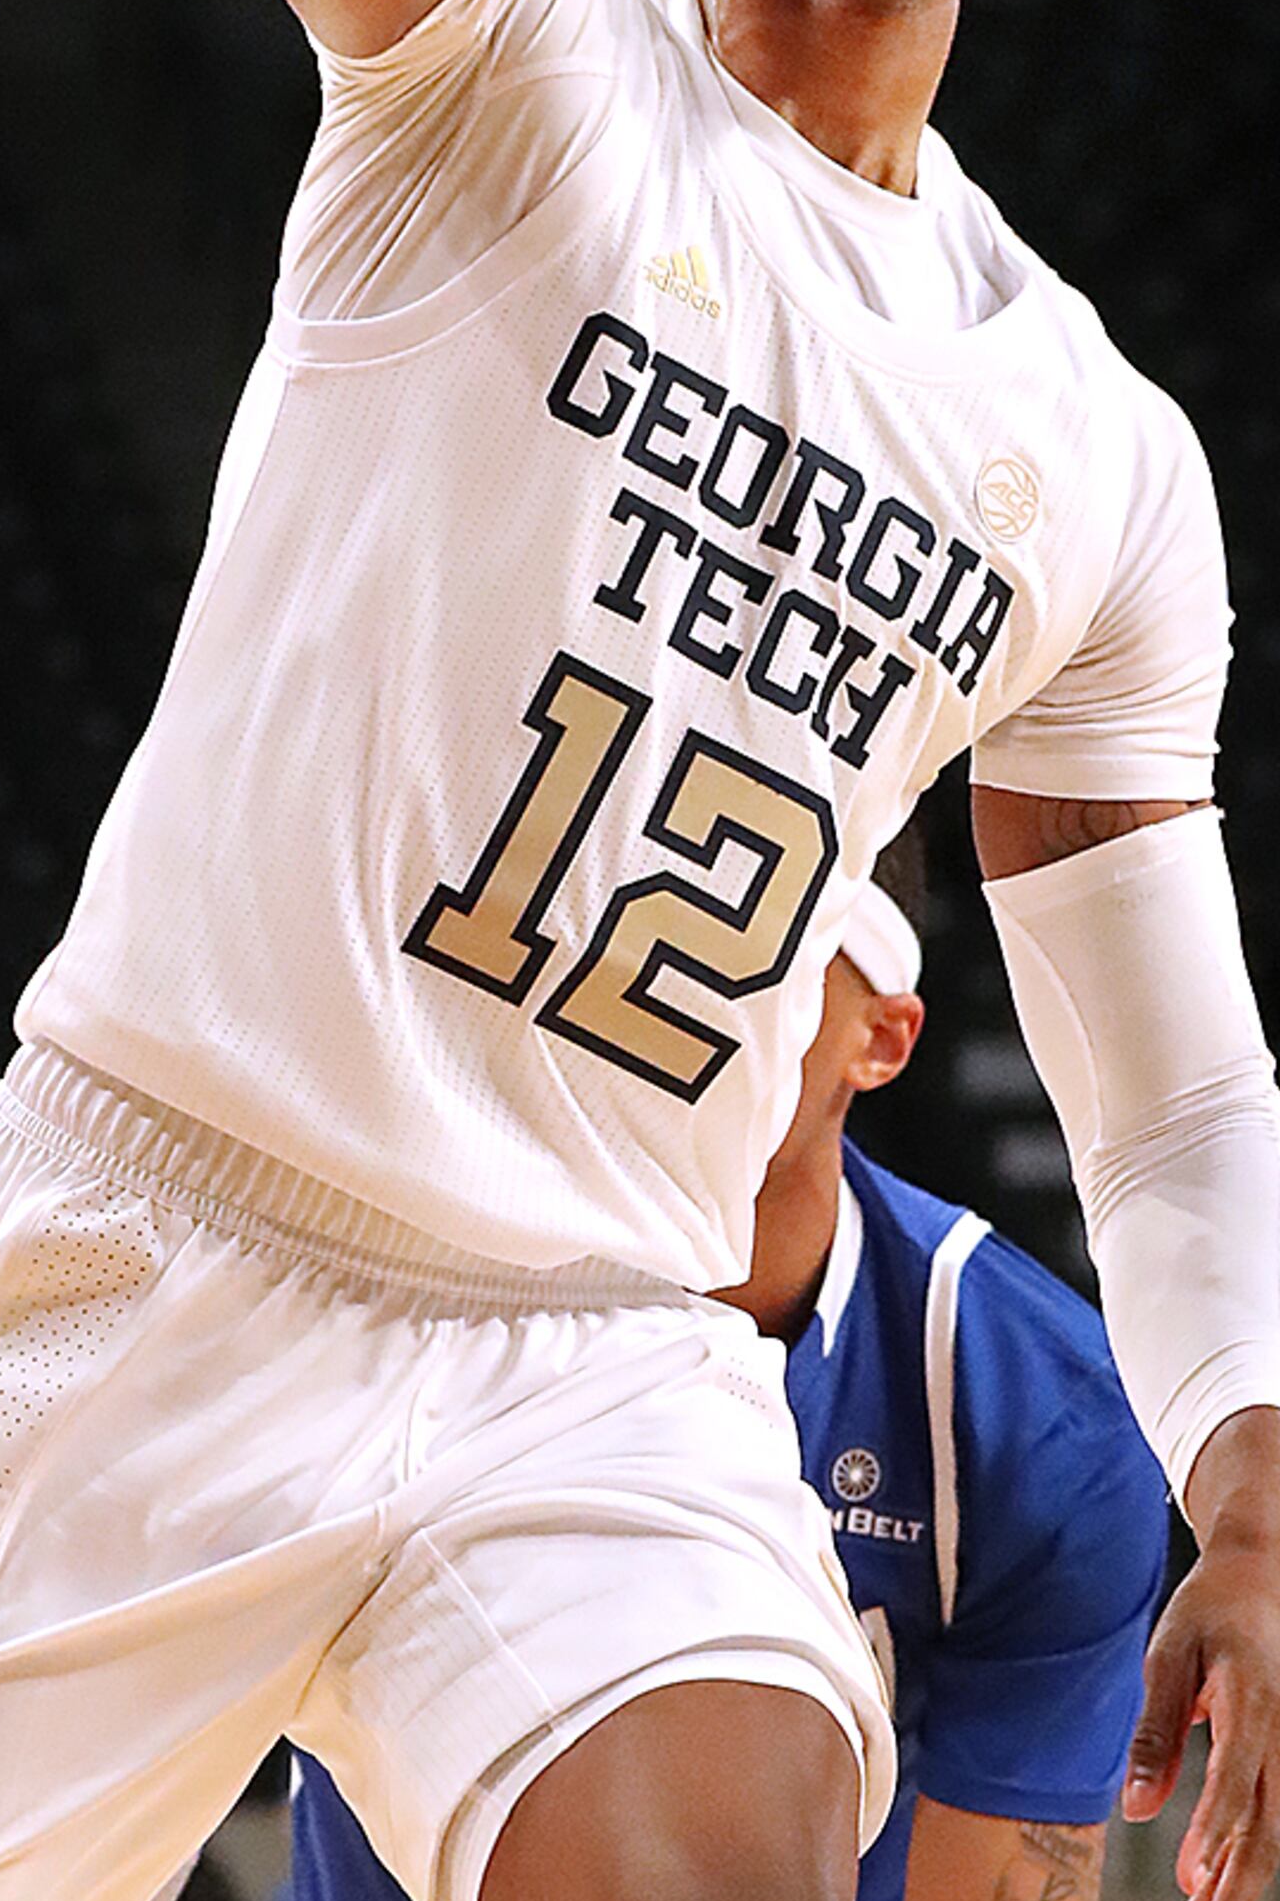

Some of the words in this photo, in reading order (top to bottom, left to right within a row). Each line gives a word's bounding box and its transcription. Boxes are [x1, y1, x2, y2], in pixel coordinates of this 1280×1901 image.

[546, 311, 1015, 696] GEORGIA
[593, 488, 915, 770] TECH
[401, 650, 839, 1105] 12
[847, 1507, 924, 1542] BELT
